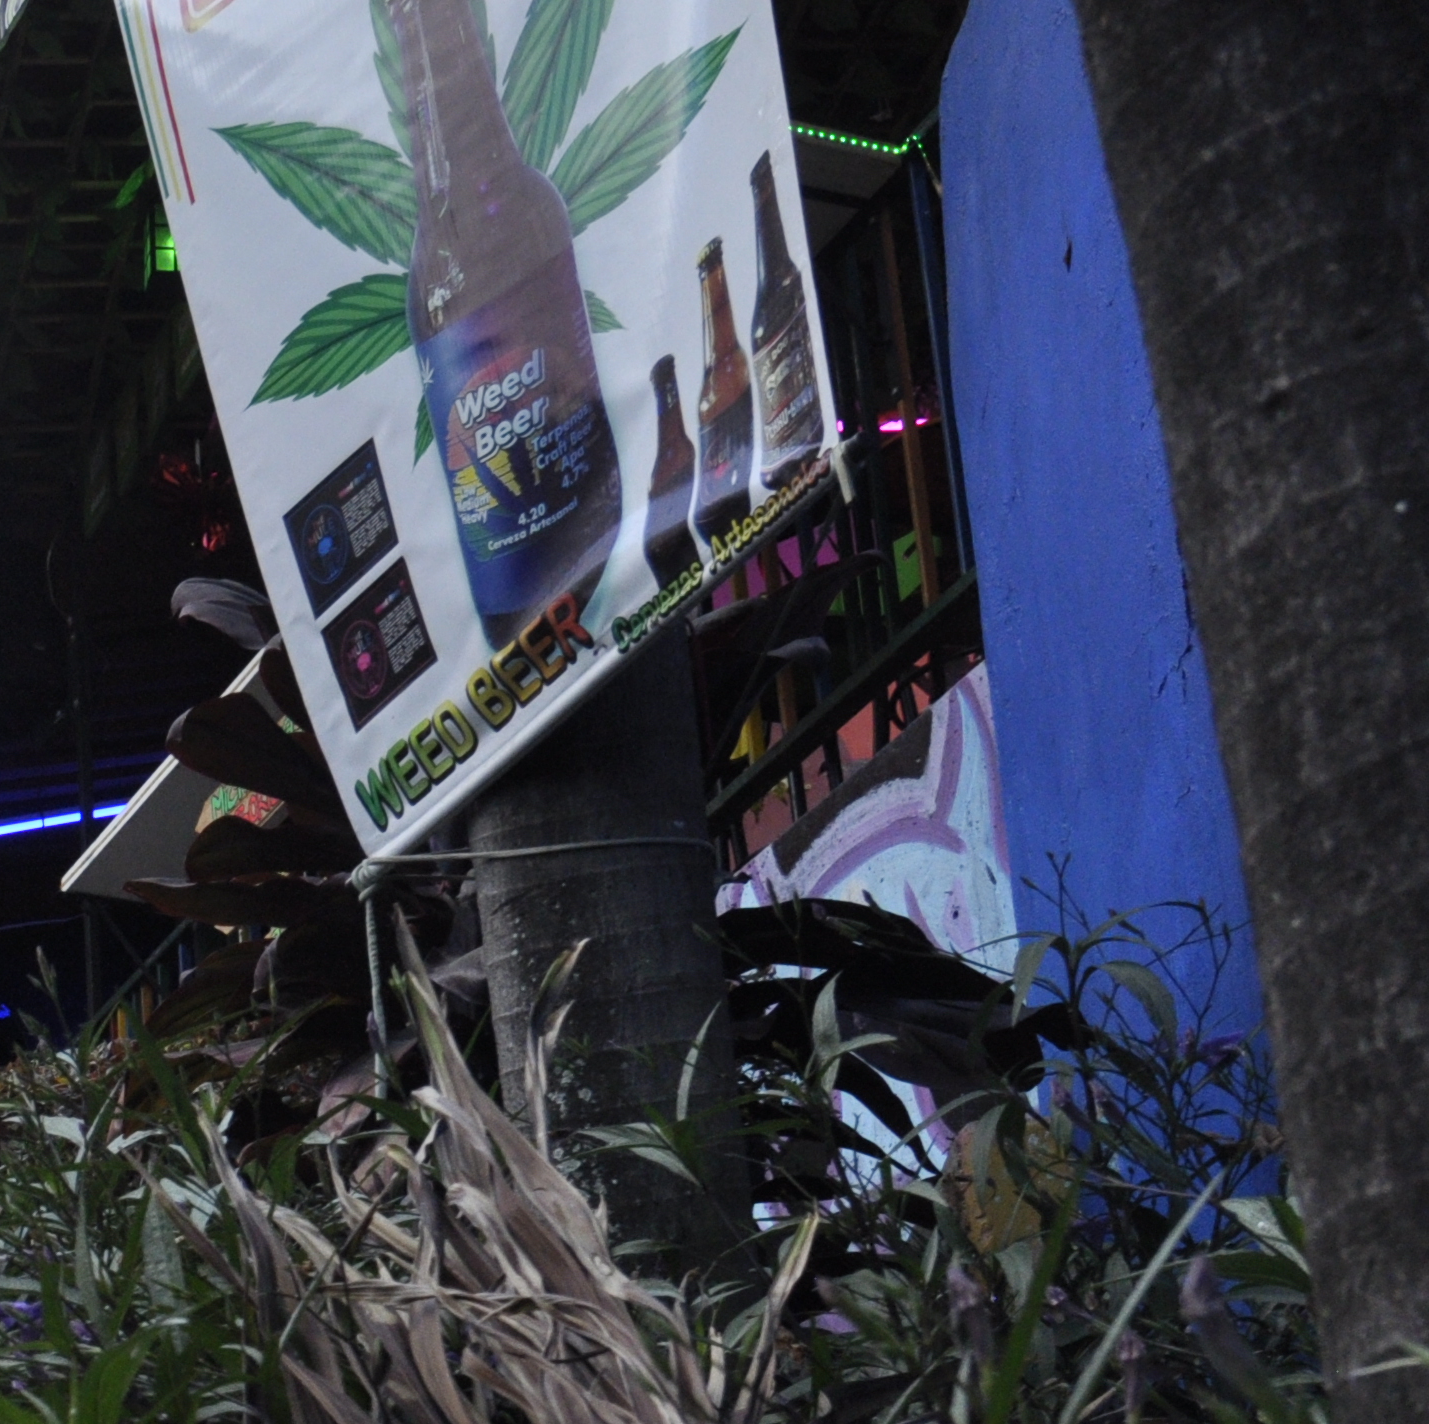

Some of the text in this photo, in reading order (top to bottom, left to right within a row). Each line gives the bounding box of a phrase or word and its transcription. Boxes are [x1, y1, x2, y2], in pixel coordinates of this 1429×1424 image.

[455, 348, 546, 429] Weed
[474, 396, 550, 464] Beer
[536, 439, 568, 470] Craft
[487, 495, 579, 551] Cerveza Artesanal
[517, 502, 547, 526] 4.20
[354, 699, 478, 833] WEED
[466, 592, 595, 732] BEER
